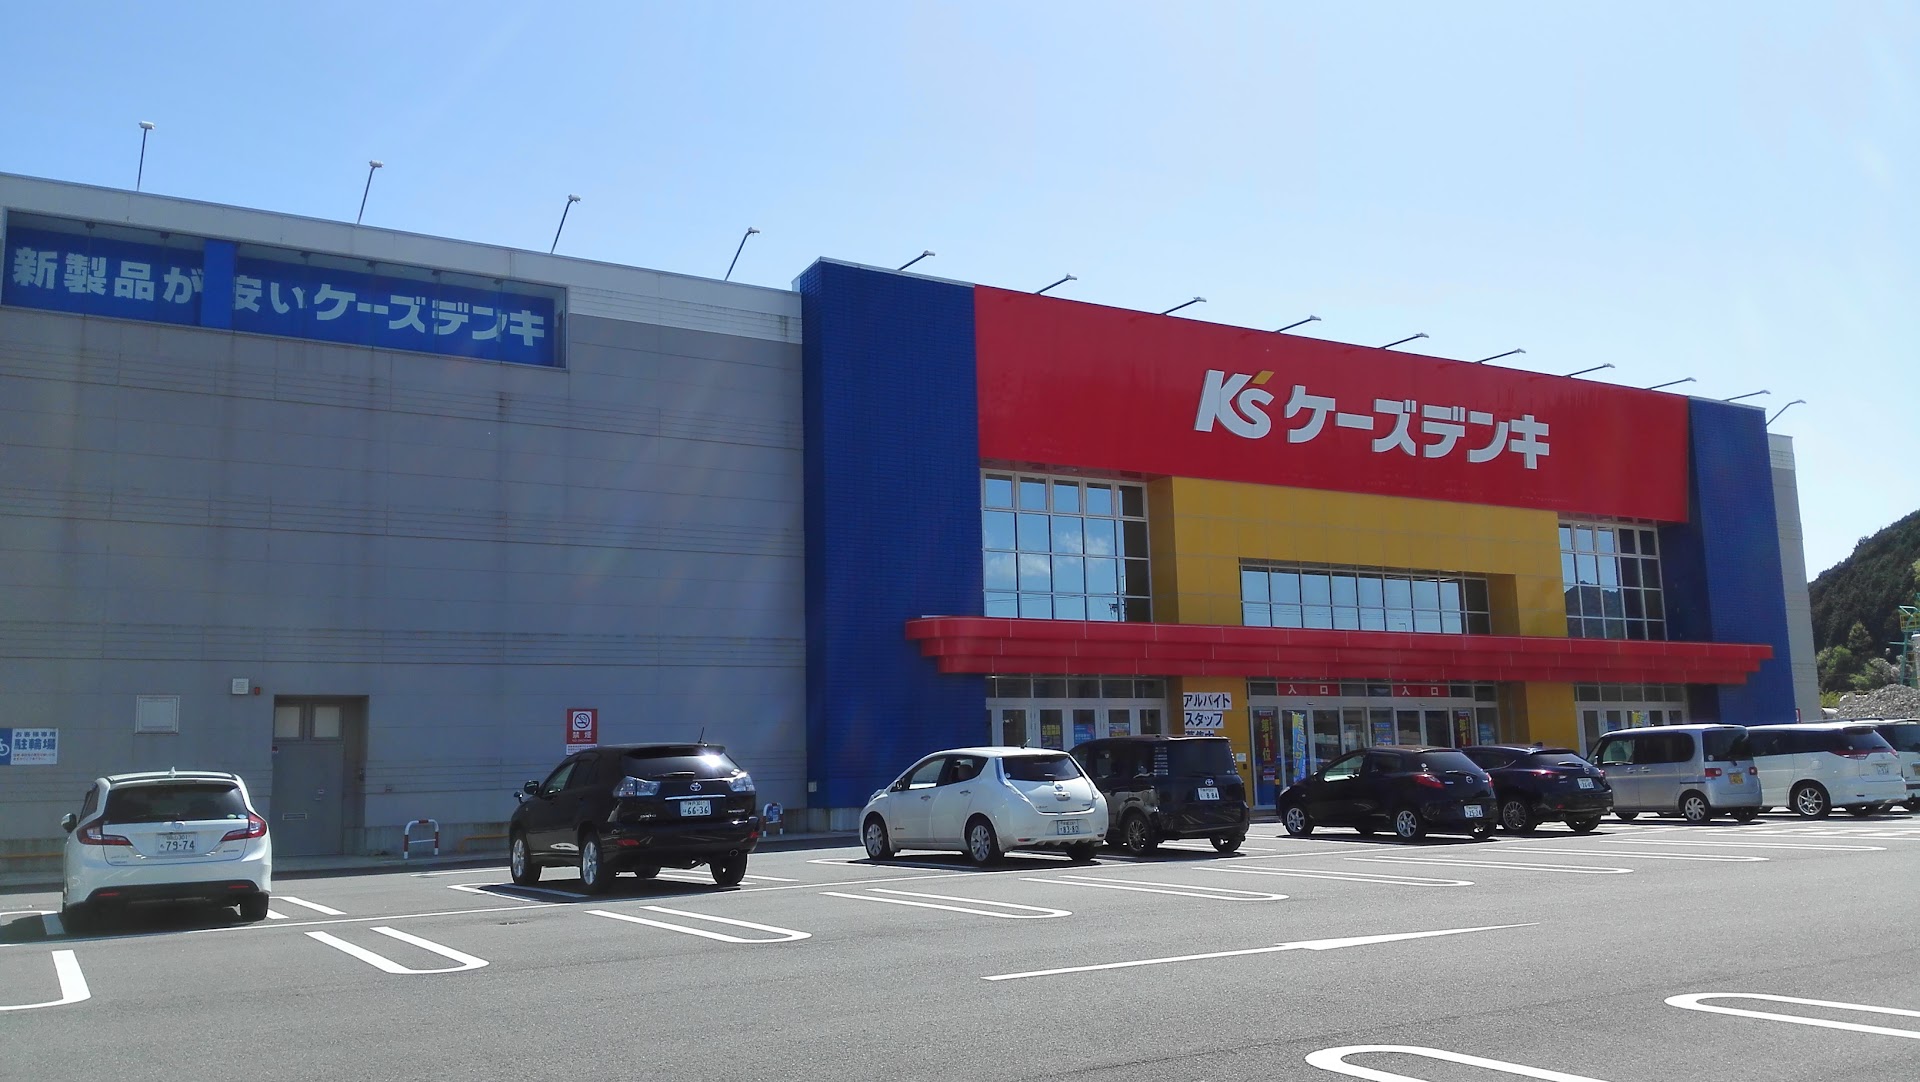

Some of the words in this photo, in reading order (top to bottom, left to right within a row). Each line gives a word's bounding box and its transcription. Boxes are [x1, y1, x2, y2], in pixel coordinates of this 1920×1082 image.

[1284, 384, 1550, 470] ケーズデンキ
[1288, 684, 1329, 695] 入口
[1402, 686, 1439, 696] 入口
[1183, 693, 1230, 708] アルバイト
[1185, 712, 1223, 727] スタッフ
[14, 738, 56, 750] 駐輪場
[687, 806, 709, 815] 66-36
[166, 840, 195, 851] 79-74
